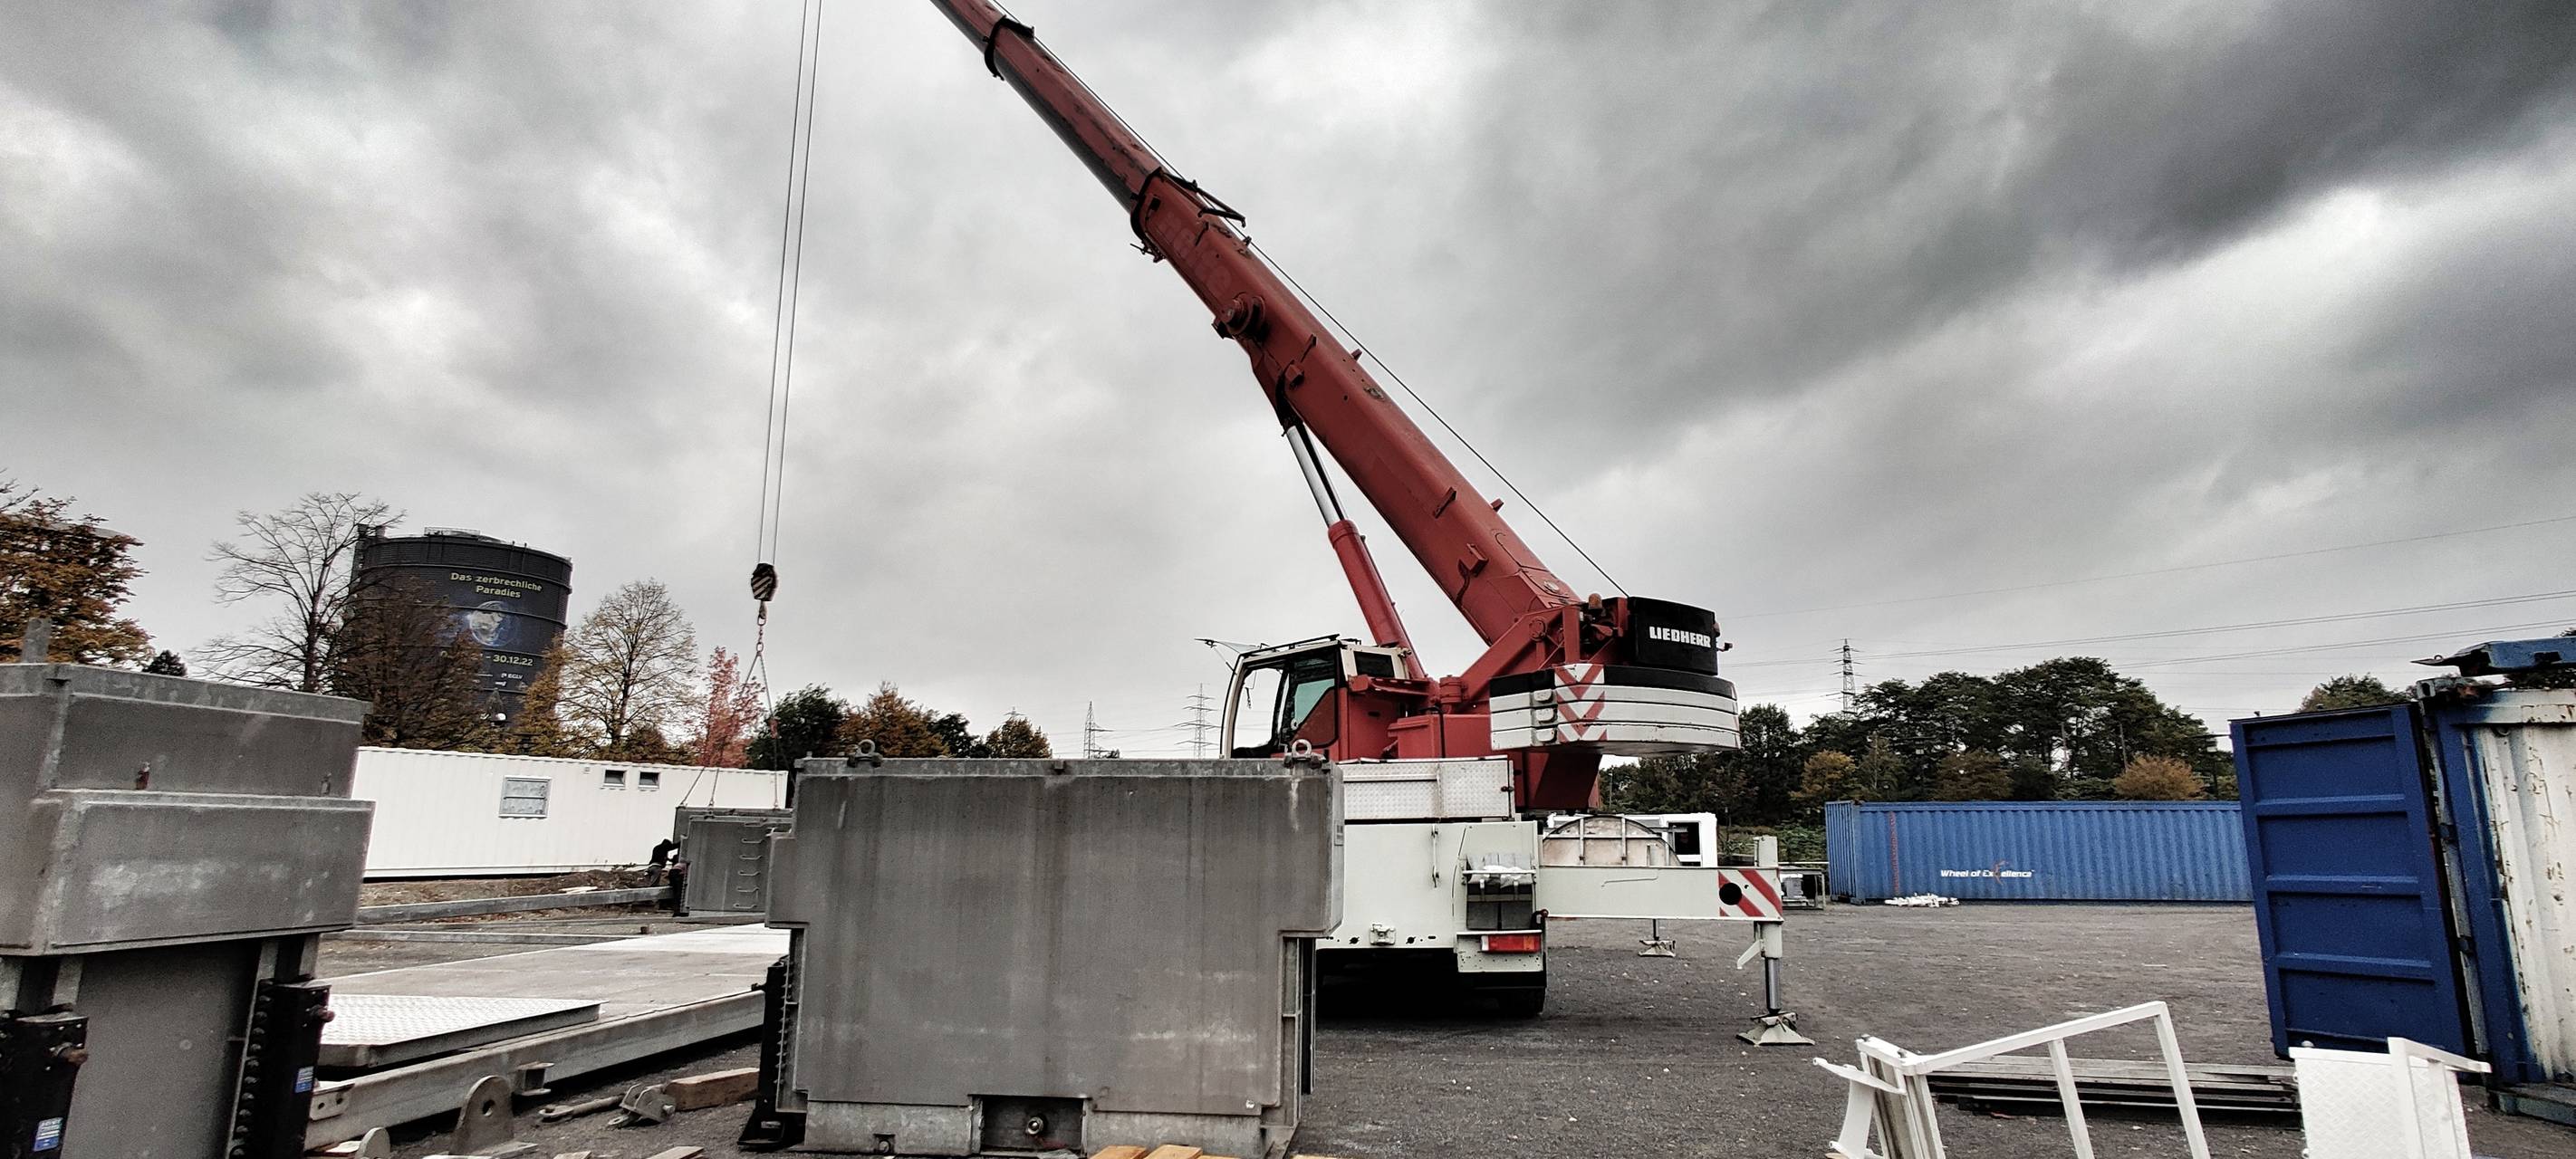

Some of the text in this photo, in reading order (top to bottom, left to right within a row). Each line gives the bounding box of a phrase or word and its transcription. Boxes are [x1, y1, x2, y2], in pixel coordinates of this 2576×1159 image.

[450, 572, 543, 591] Das zerbrechliche
[476, 585, 521, 598] Paradies
[493, 654, 533, 666] 30.12.22
[1940, 869, 1968, 877] Wheel
[1970, 869, 1981, 877] of
